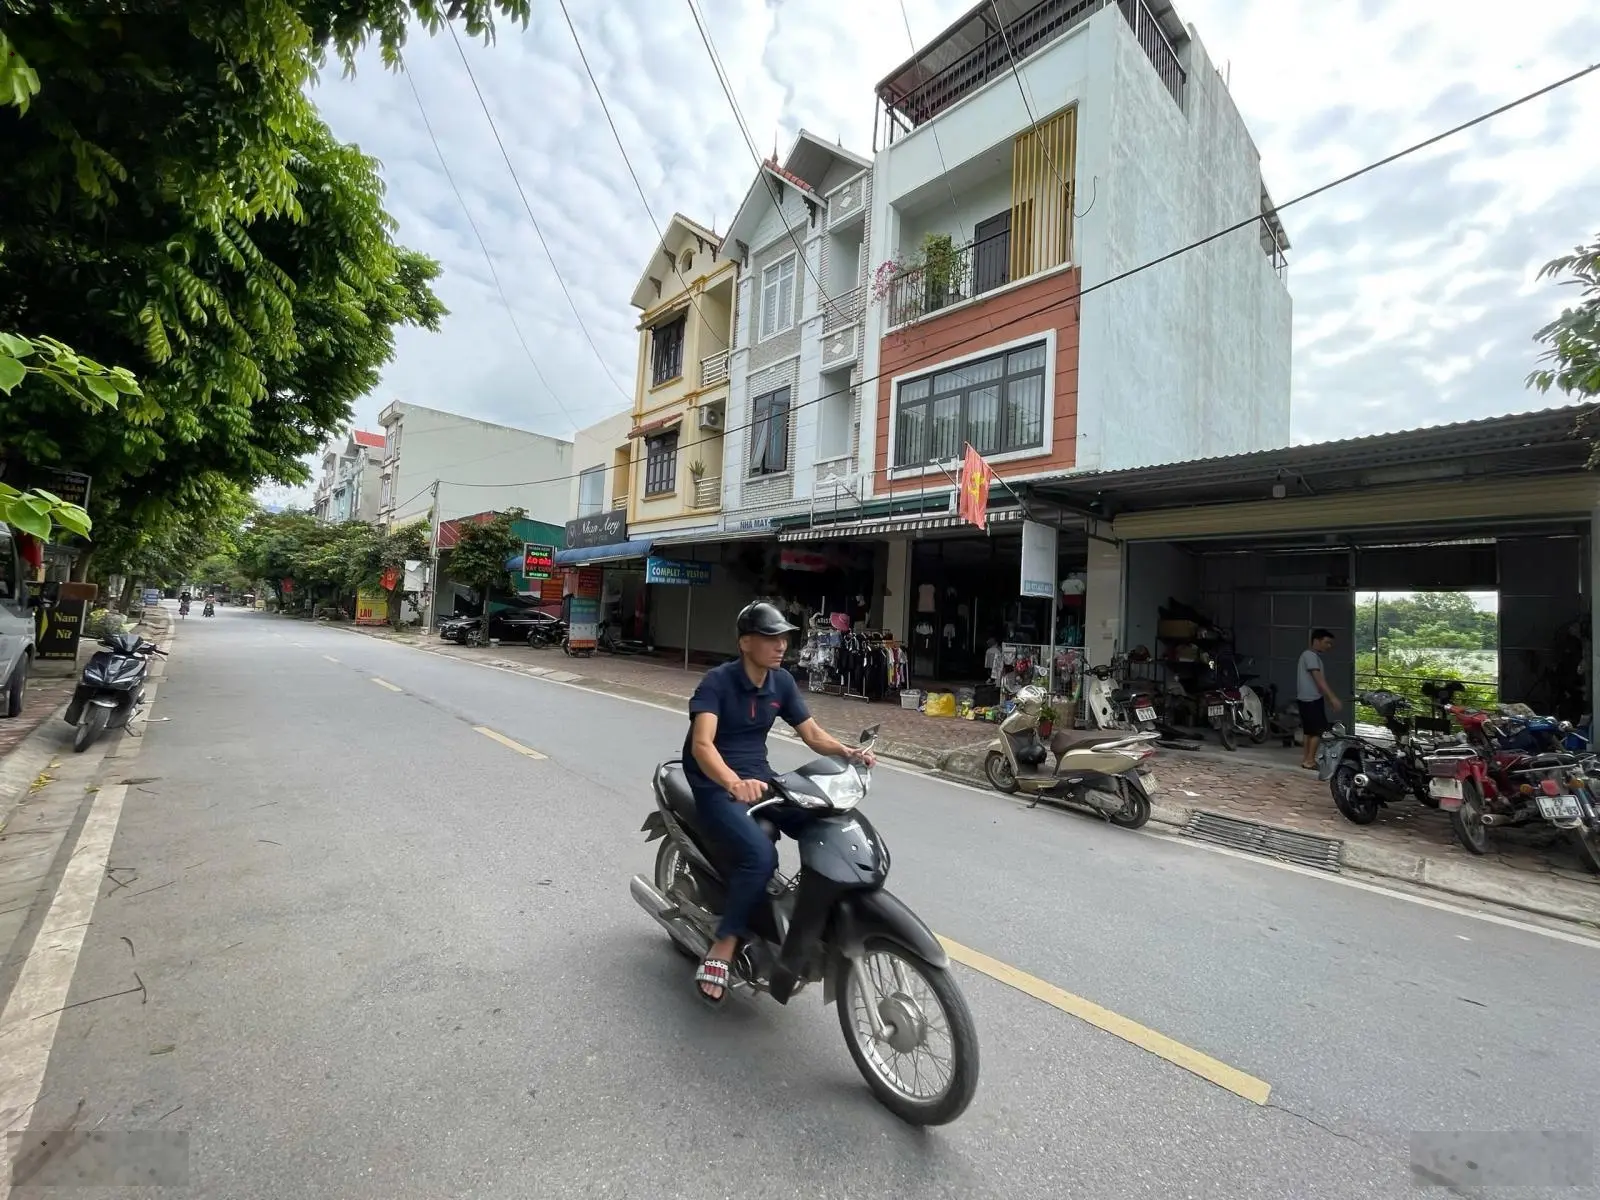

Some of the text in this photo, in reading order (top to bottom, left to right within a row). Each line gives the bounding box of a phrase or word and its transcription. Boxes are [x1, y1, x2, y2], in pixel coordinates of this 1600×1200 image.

[652, 566, 680, 577] COMPLET
[54, 611, 78, 623] Nam
[56, 628, 73, 639] Nữ
